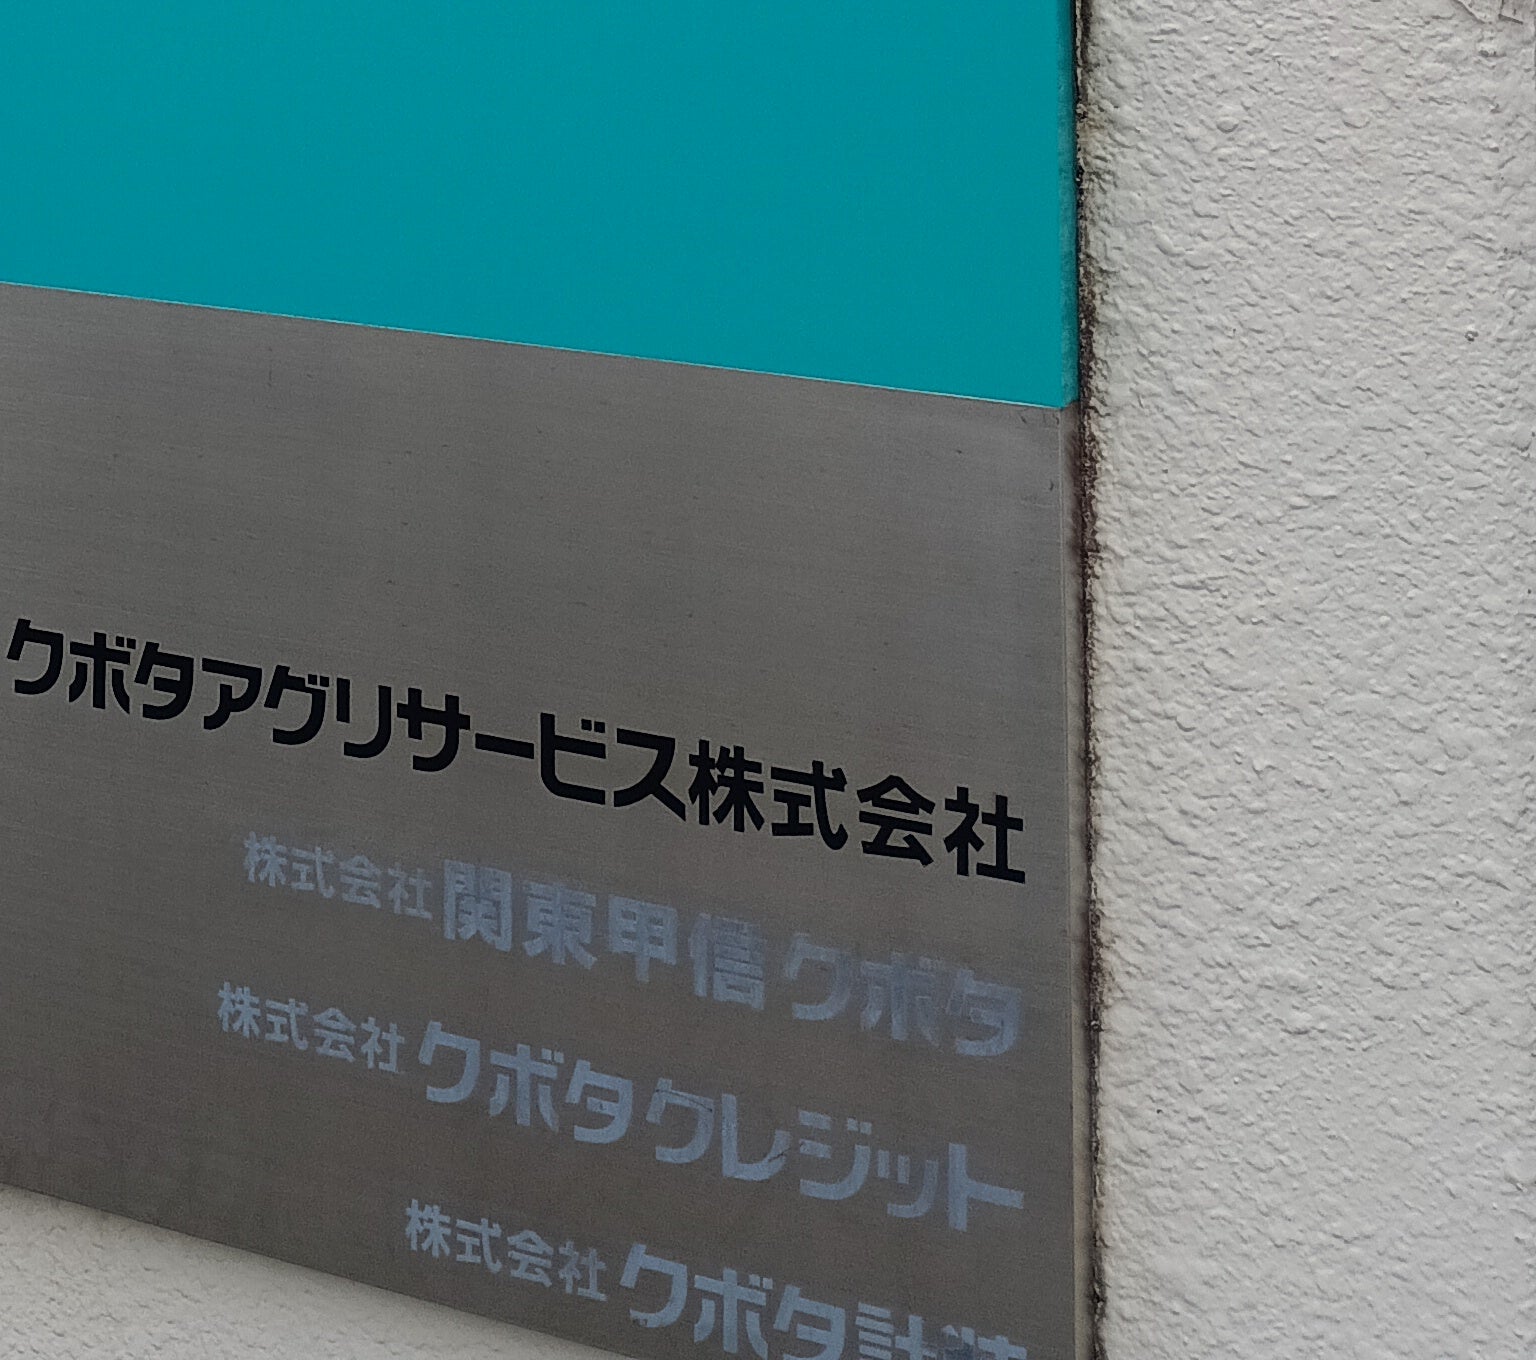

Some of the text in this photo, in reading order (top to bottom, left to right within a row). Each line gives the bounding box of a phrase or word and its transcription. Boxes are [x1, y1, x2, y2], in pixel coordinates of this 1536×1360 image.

[6, 618, 1026, 884] クボタアグリサービス株式会社
